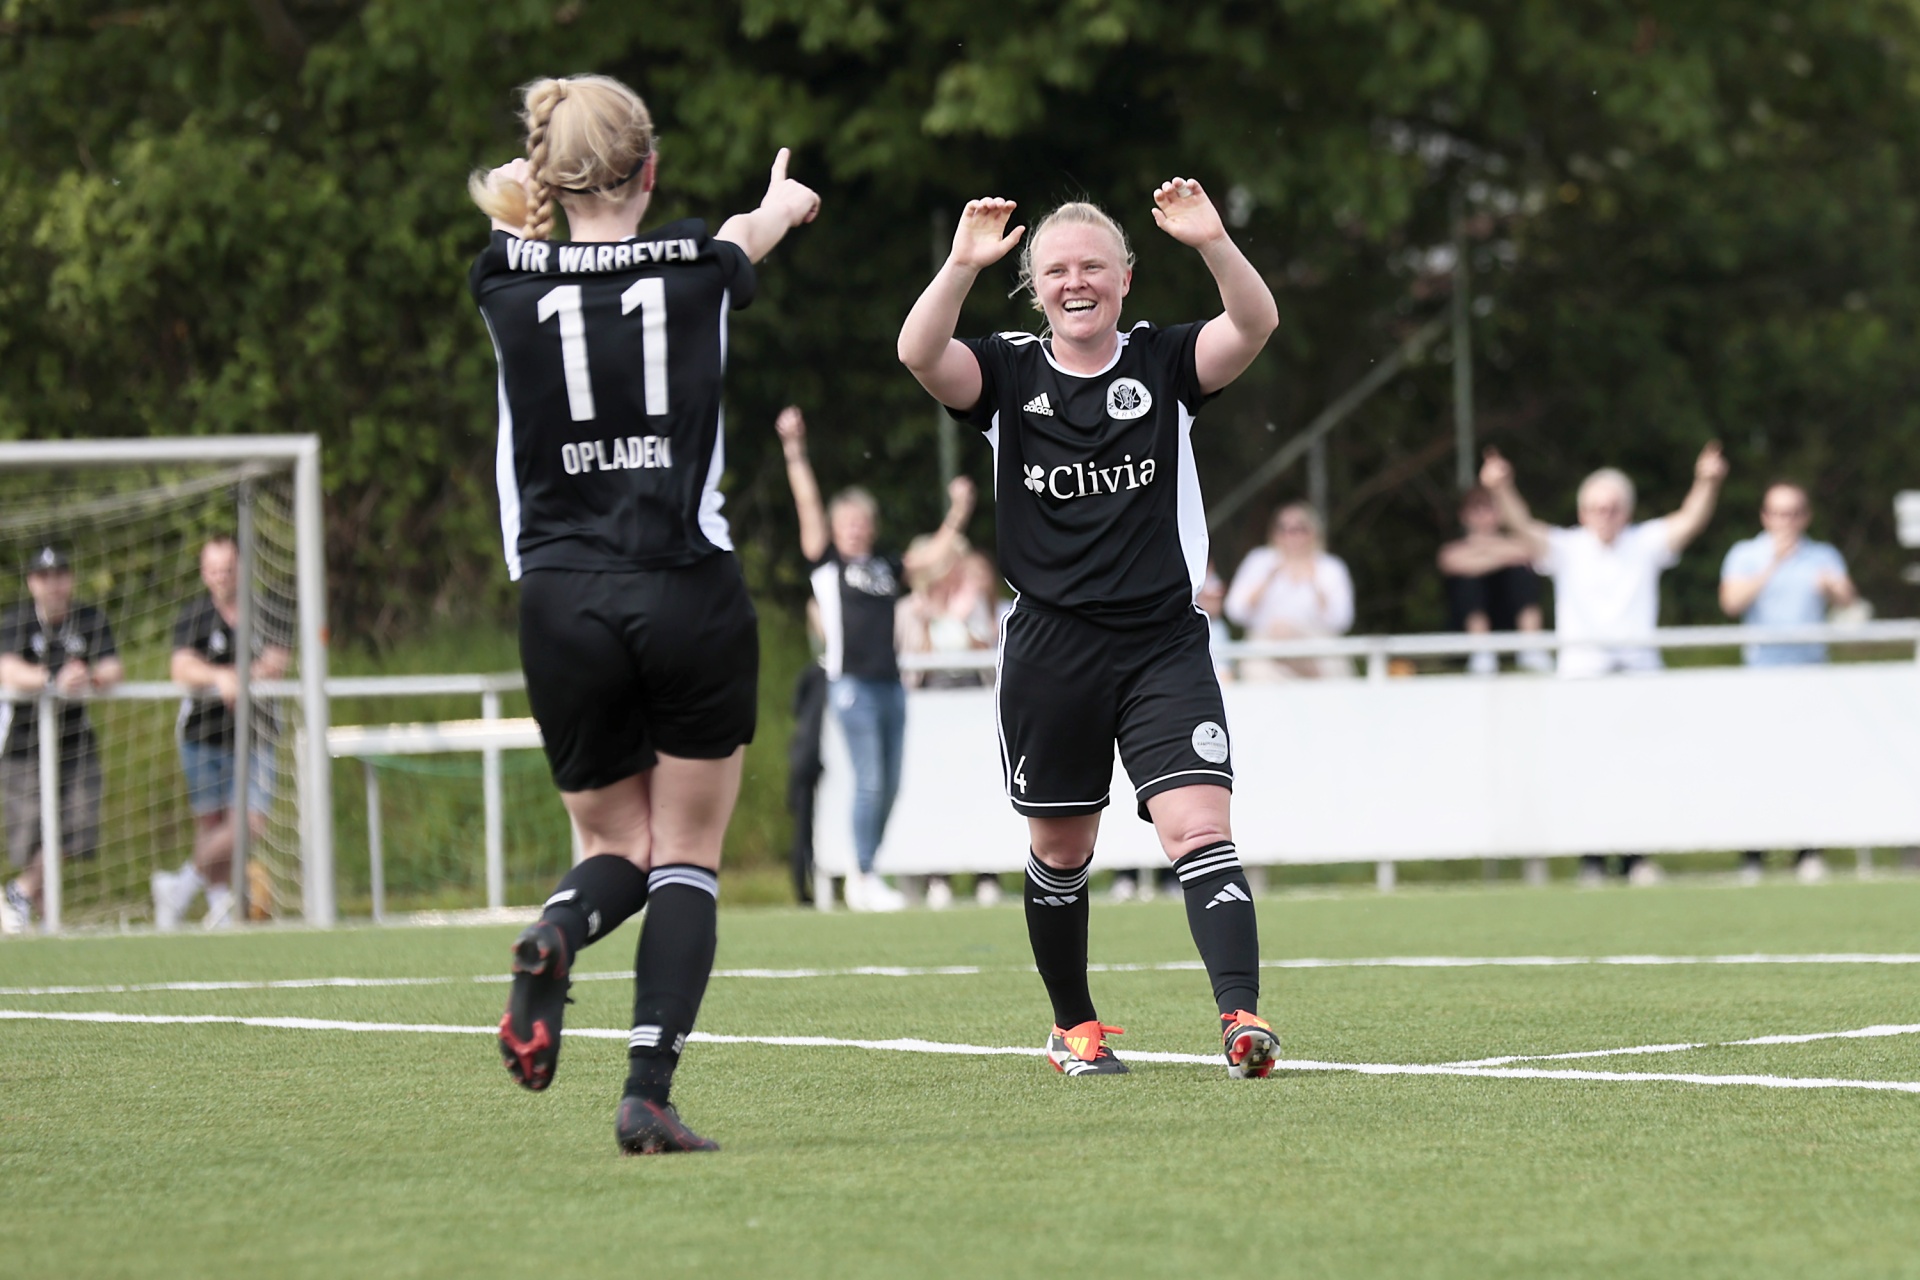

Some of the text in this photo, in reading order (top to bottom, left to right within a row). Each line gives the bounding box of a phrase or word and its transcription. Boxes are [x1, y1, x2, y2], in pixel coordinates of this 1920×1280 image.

[506, 237, 551, 273] VfR
[537, 277, 670, 422] 11
[1023, 404, 1054, 417] adidas
[561, 435, 673, 476] OPLADEN
[1048, 454, 1156, 500] Clivia
[1013, 755, 1027, 795] 4
